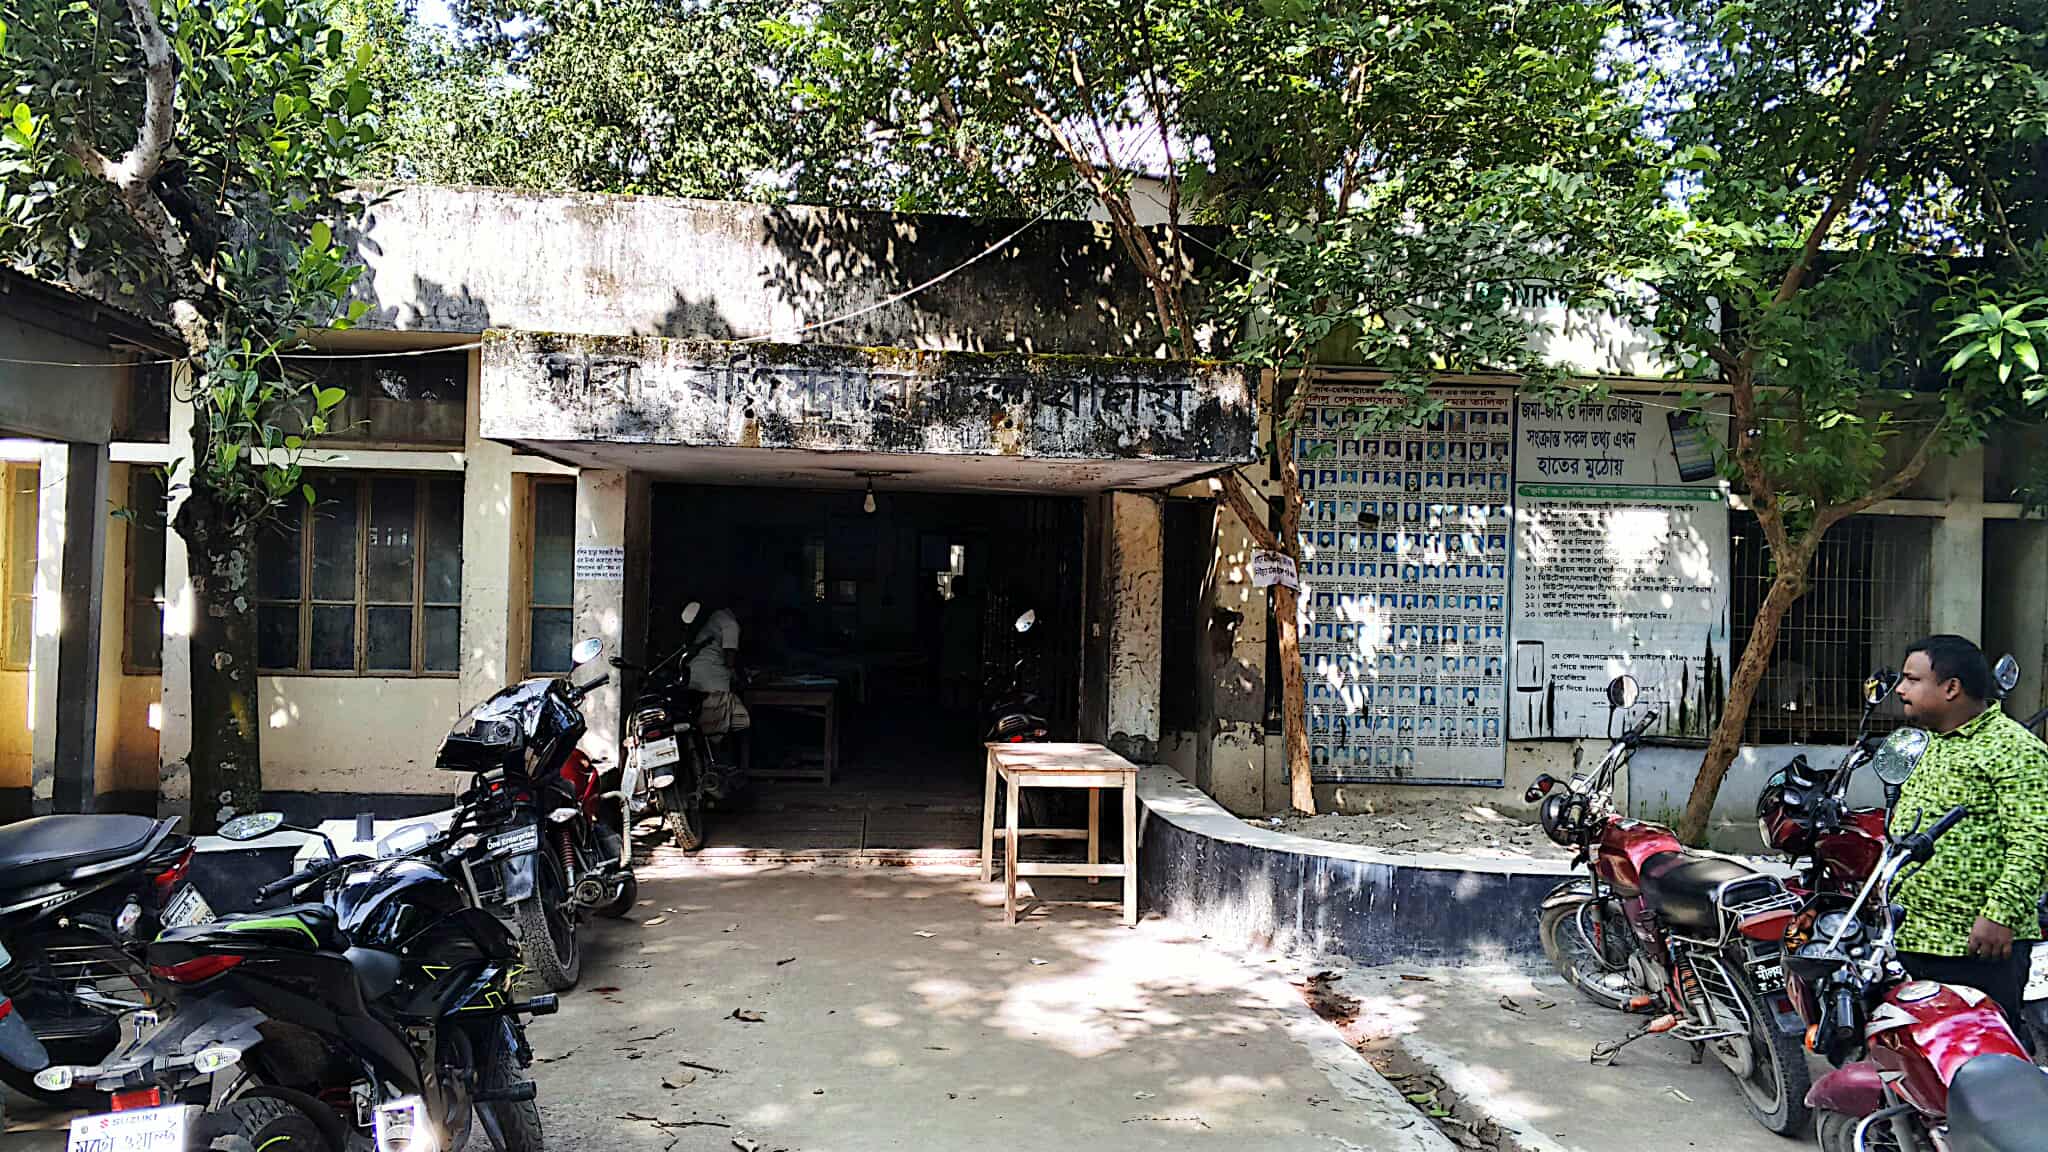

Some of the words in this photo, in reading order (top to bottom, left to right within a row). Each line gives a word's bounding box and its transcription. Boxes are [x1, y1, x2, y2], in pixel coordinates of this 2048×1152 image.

[1578, 397, 1605, 423] দলিল
[1563, 430, 1589, 449] সকল
[1590, 429, 1611, 450] তথ্য
[1613, 429, 1637, 449] এখন
[1536, 456, 1580, 477] হাতের
[1583, 450, 1625, 481] মুঠোয়
